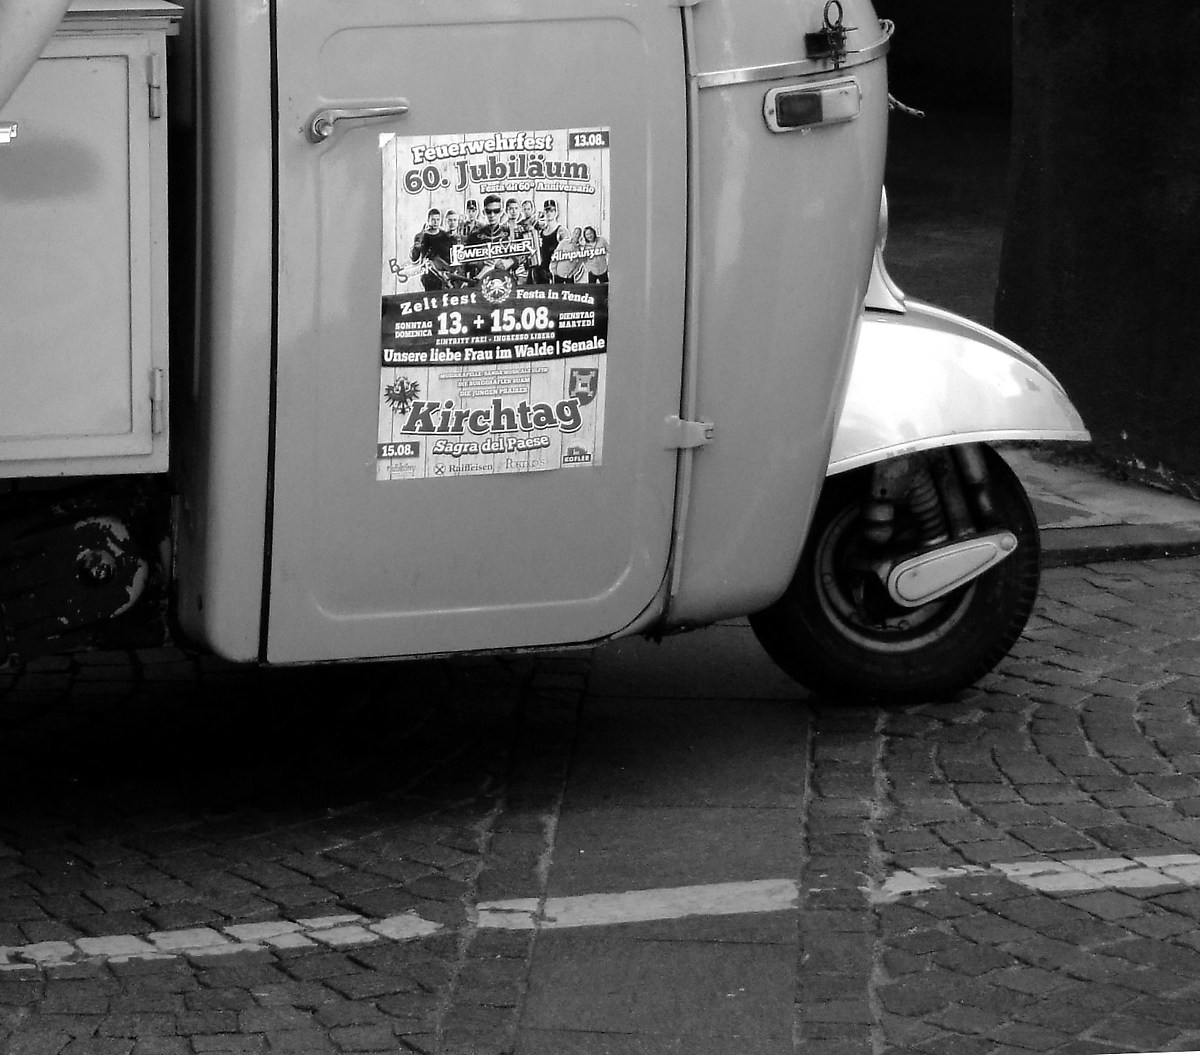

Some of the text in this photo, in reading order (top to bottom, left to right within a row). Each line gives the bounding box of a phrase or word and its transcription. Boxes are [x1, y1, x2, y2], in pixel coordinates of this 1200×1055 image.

[412, 133, 553, 163] Feuerwehrfest
[573, 134, 606, 148] 13.08.
[405, 154, 590, 193] 60. Jubiläum
[401, 292, 477, 316] Zelt fest
[516, 289, 595, 305] Festa in Tenda
[395, 321, 433, 330] SONNTAG
[437, 306, 555, 335] 13. + 15.08.
[383, 349, 427, 362] Unsere
[429, 348, 462, 362] liebe
[464, 347, 493, 361] Frau
[495, 346, 513, 359] im
[514, 341, 553, 358] Walde
[562, 336, 606, 353] Senale
[401, 397, 583, 435] Kirchtag
[381, 444, 415, 457] 15.08.
[433, 435, 550, 457] Sagra del Paese
[449, 463, 493, 473] Raiffeisen
